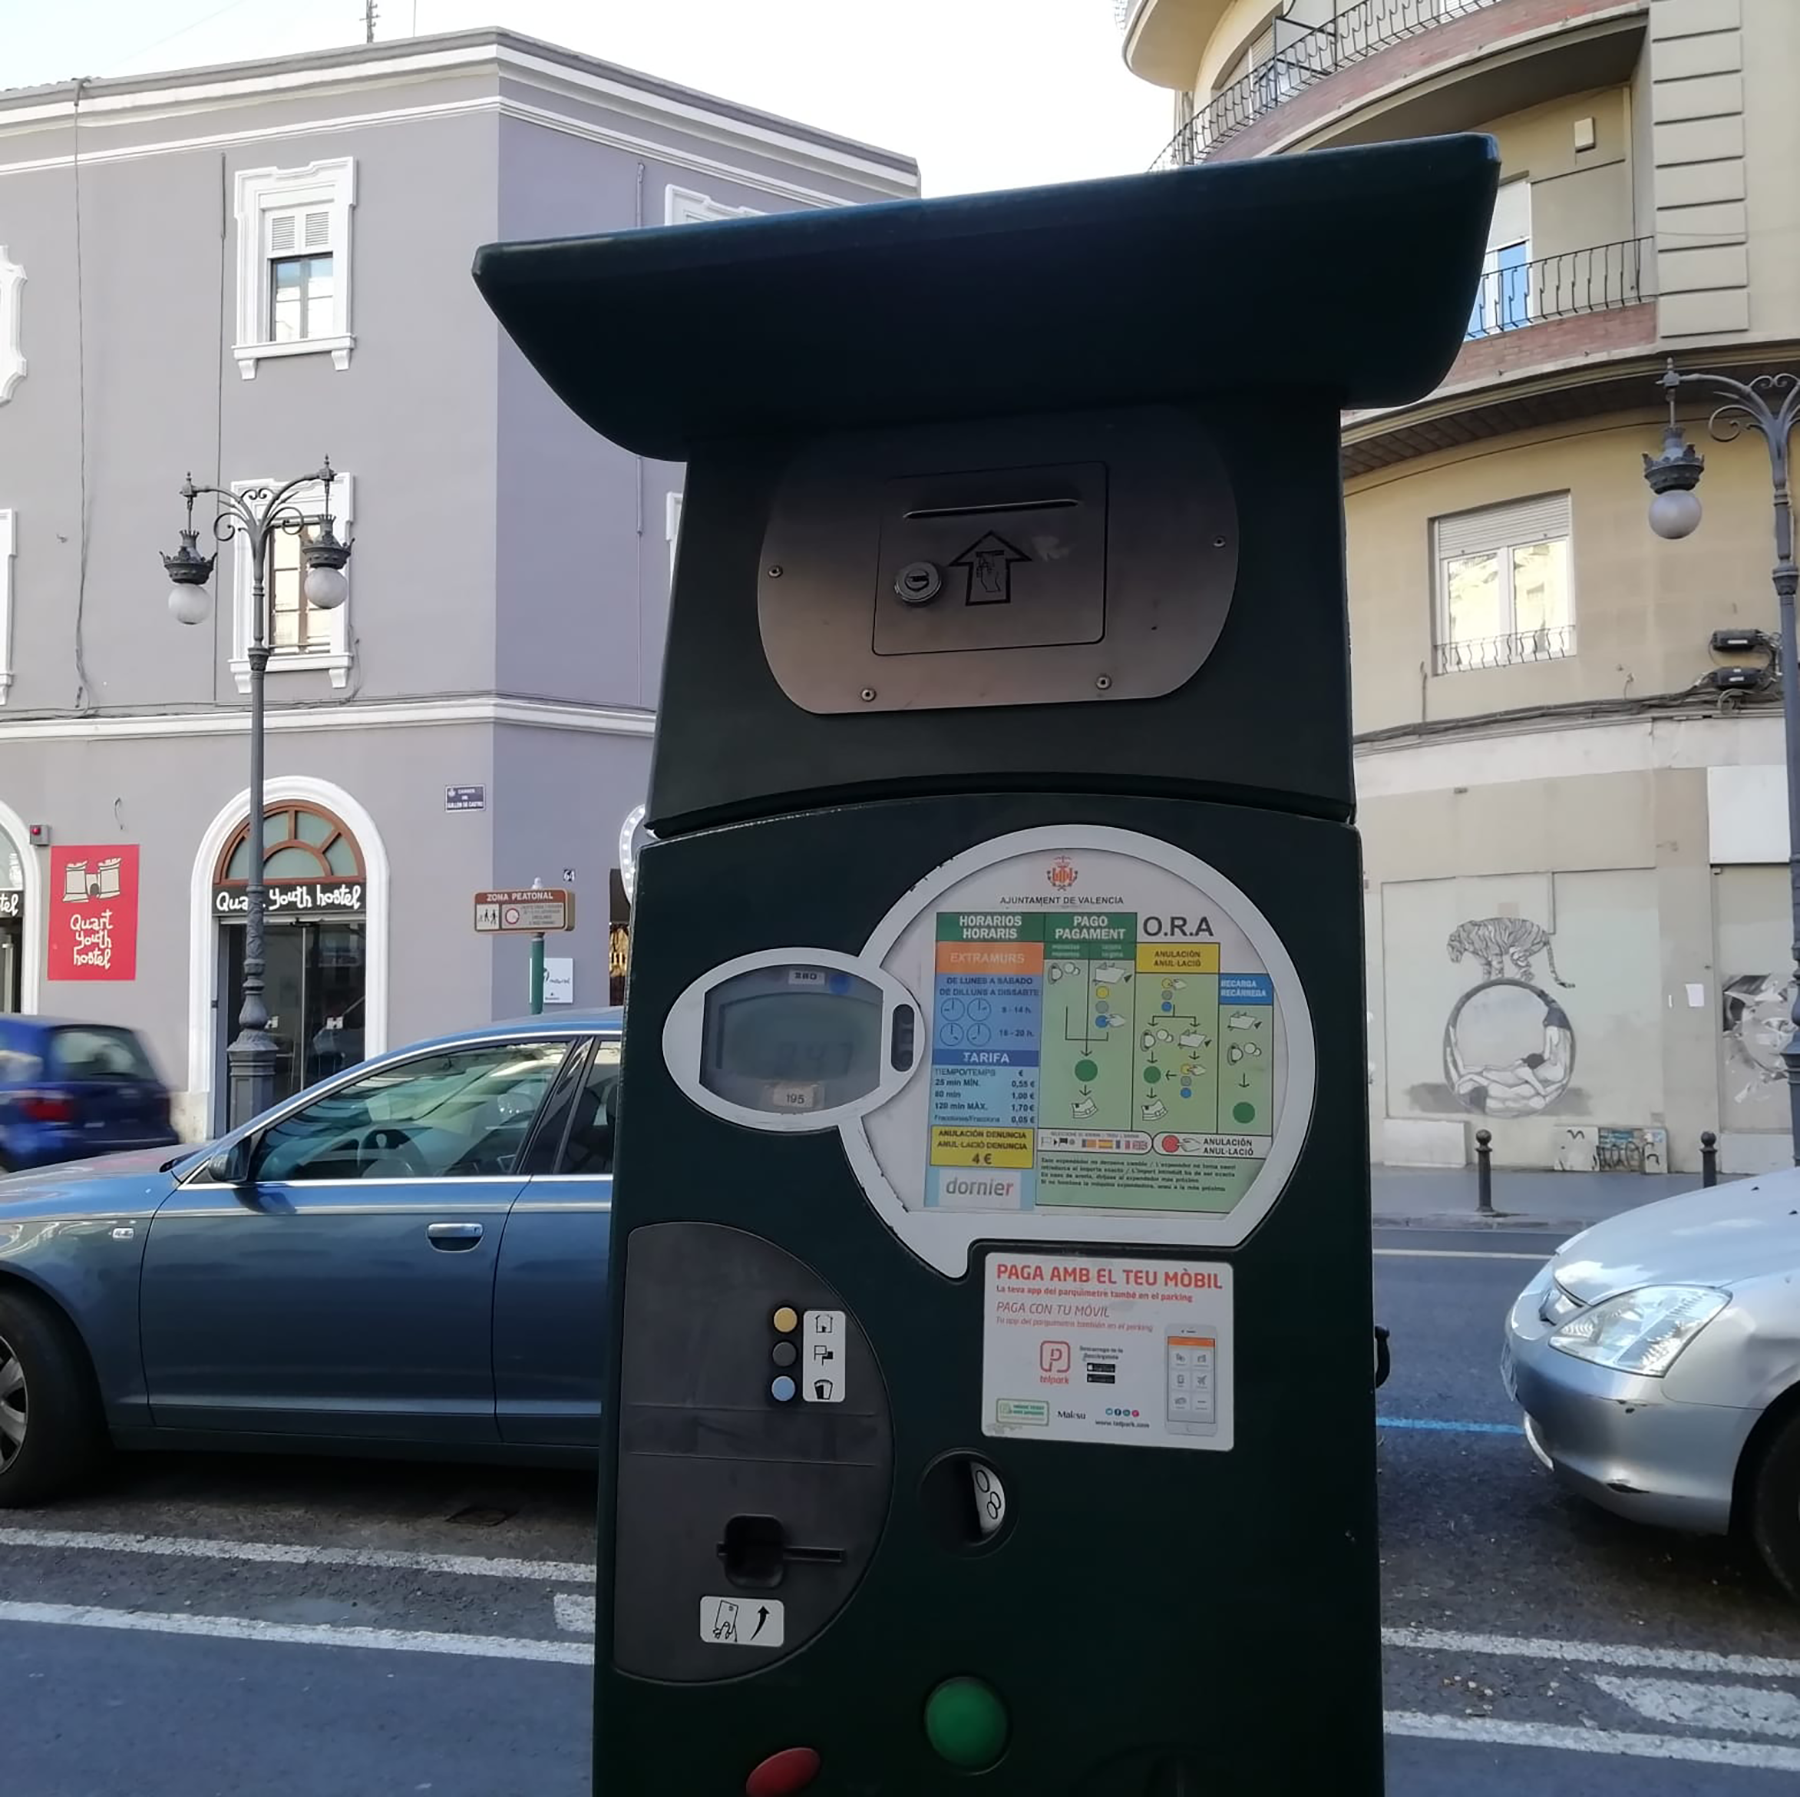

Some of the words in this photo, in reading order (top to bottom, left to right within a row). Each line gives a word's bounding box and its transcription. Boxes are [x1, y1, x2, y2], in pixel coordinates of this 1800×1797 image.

[316, 884, 361, 911] hostel
[486, 893, 508, 902] ZONA
[512, 892, 554, 900] PEATONAL
[1000, 896, 1060, 905] AJUNTAMENT
[1063, 896, 1076, 904] DE
[1078, 896, 1124, 904] VALENCIA
[70, 909, 114, 932] Quart
[960, 915, 1022, 927] HORARIOS
[1073, 916, 1108, 927] PAGO
[1143, 916, 1214, 937] O.R.A
[962, 928, 1018, 940] HORARIS
[1055, 928, 1126, 940] PAGAMENT
[73, 947, 112, 970] hostel
[950, 952, 1025, 964] EXTRAMURS
[1154, 950, 1201, 958] ANULACIÓN
[1220, 979, 1257, 988] RECARGA
[940, 988, 950, 996] DE
[953, 988, 988, 996] DILLUNS
[990, 988, 996, 996] A
[963, 1052, 1010, 1063] TARIFA
[946, 1078, 961, 1086] min
[786, 1094, 805, 1104] 195
[946, 1090, 961, 1098] min
[950, 1102, 965, 1110] min
[1011, 1104, 1029, 1112] 1,70
[1011, 1116, 1028, 1125] 0,05
[938, 1129, 984, 1138] ANULACIÓN
[986, 1131, 1026, 1139] DENUNCIA
[986, 1142, 1028, 1150] DENUNCIA
[1203, 1138, 1252, 1146] ANULACIÓN
[972, 1154, 980, 1164] 4
[984, 1154, 992, 1164] €
[946, 1177, 1014, 1196] dornier
[997, 1264, 1044, 1281] PAGA
[1050, 1266, 1090, 1282] AMB
[1097, 1268, 1117, 1284] EL
[1122, 1270, 1158, 1286] TEU
[1164, 1268, 1222, 1289] MÒBIL
[1008, 1286, 1026, 1294] teva
[1044, 1287, 1056, 1295] del
[1151, 1292, 1159, 1300] el
[1160, 1292, 1193, 1303] parking
[996, 1302, 1026, 1312] PAGA
[1029, 1303, 1052, 1314] CON
[1057, 1304, 1072, 1316] TU
[1074, 1304, 1110, 1318] MÓVIL
[996, 1316, 1004, 1324] Tu
[1020, 1317, 1032, 1325] del
[1118, 1322, 1126, 1330] el
[1126, 1324, 1153, 1332] parking
[1040, 1376, 1069, 1385] telpark
